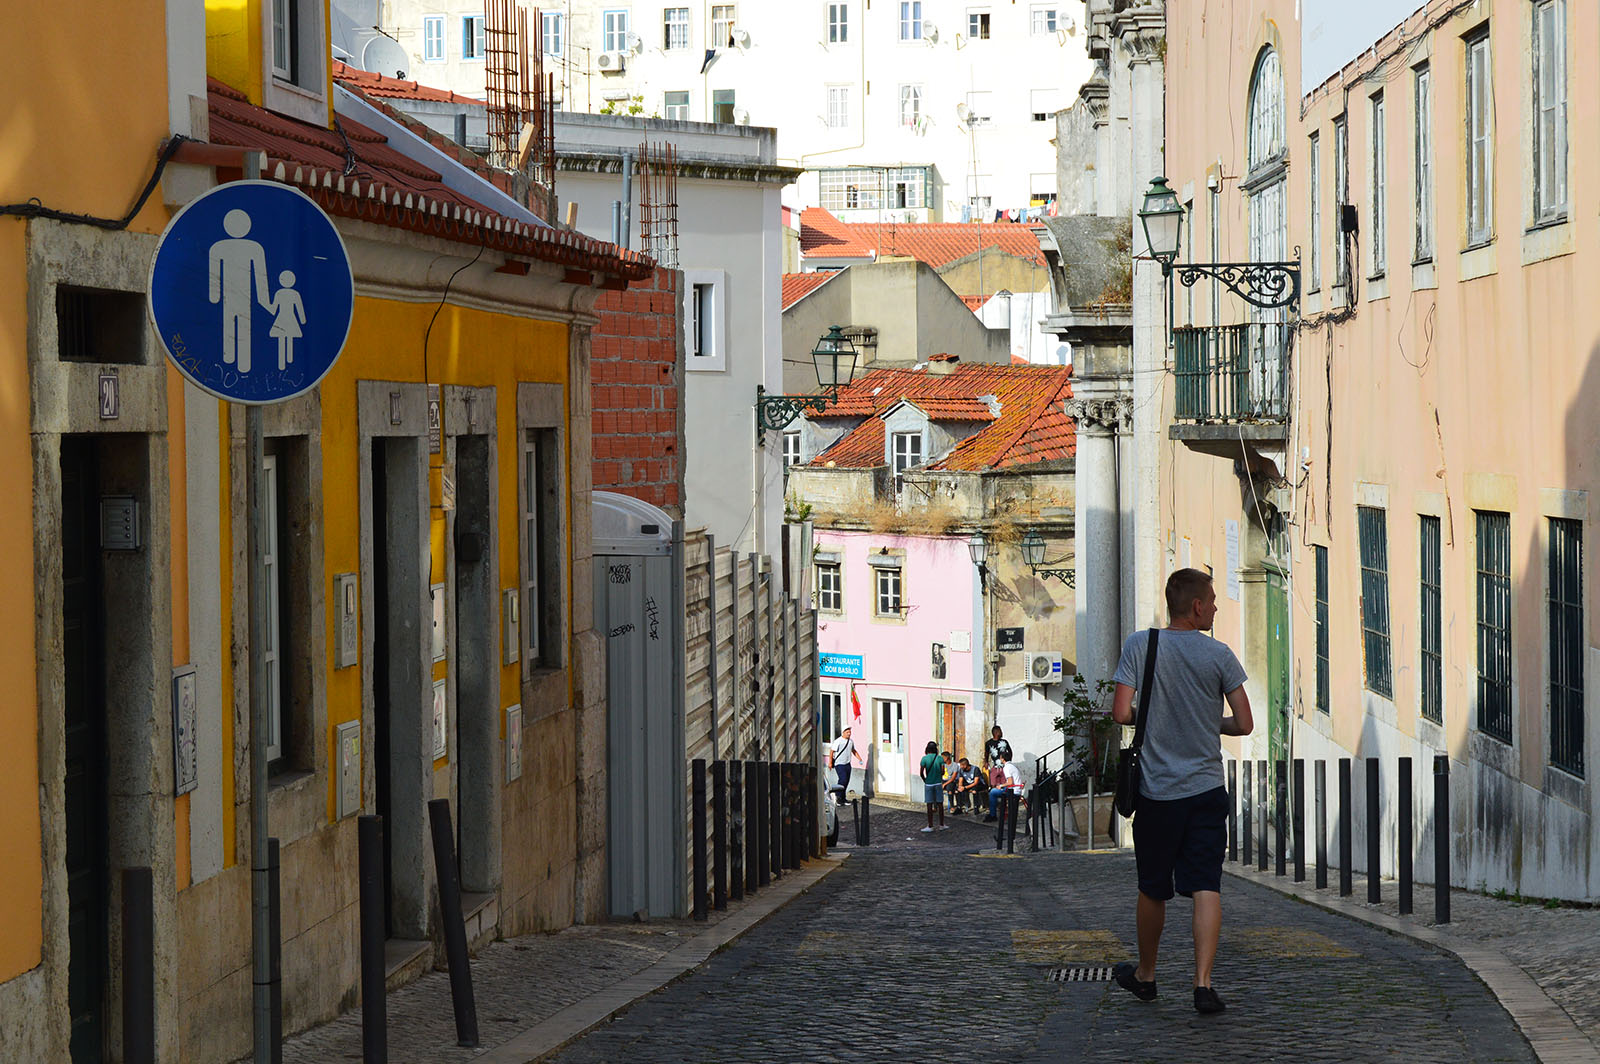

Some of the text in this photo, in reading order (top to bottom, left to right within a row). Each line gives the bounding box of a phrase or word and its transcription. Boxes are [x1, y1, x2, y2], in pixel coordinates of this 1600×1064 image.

[103, 380, 115, 415] 20
[825, 665, 859, 675] DOM BASÍLIO
